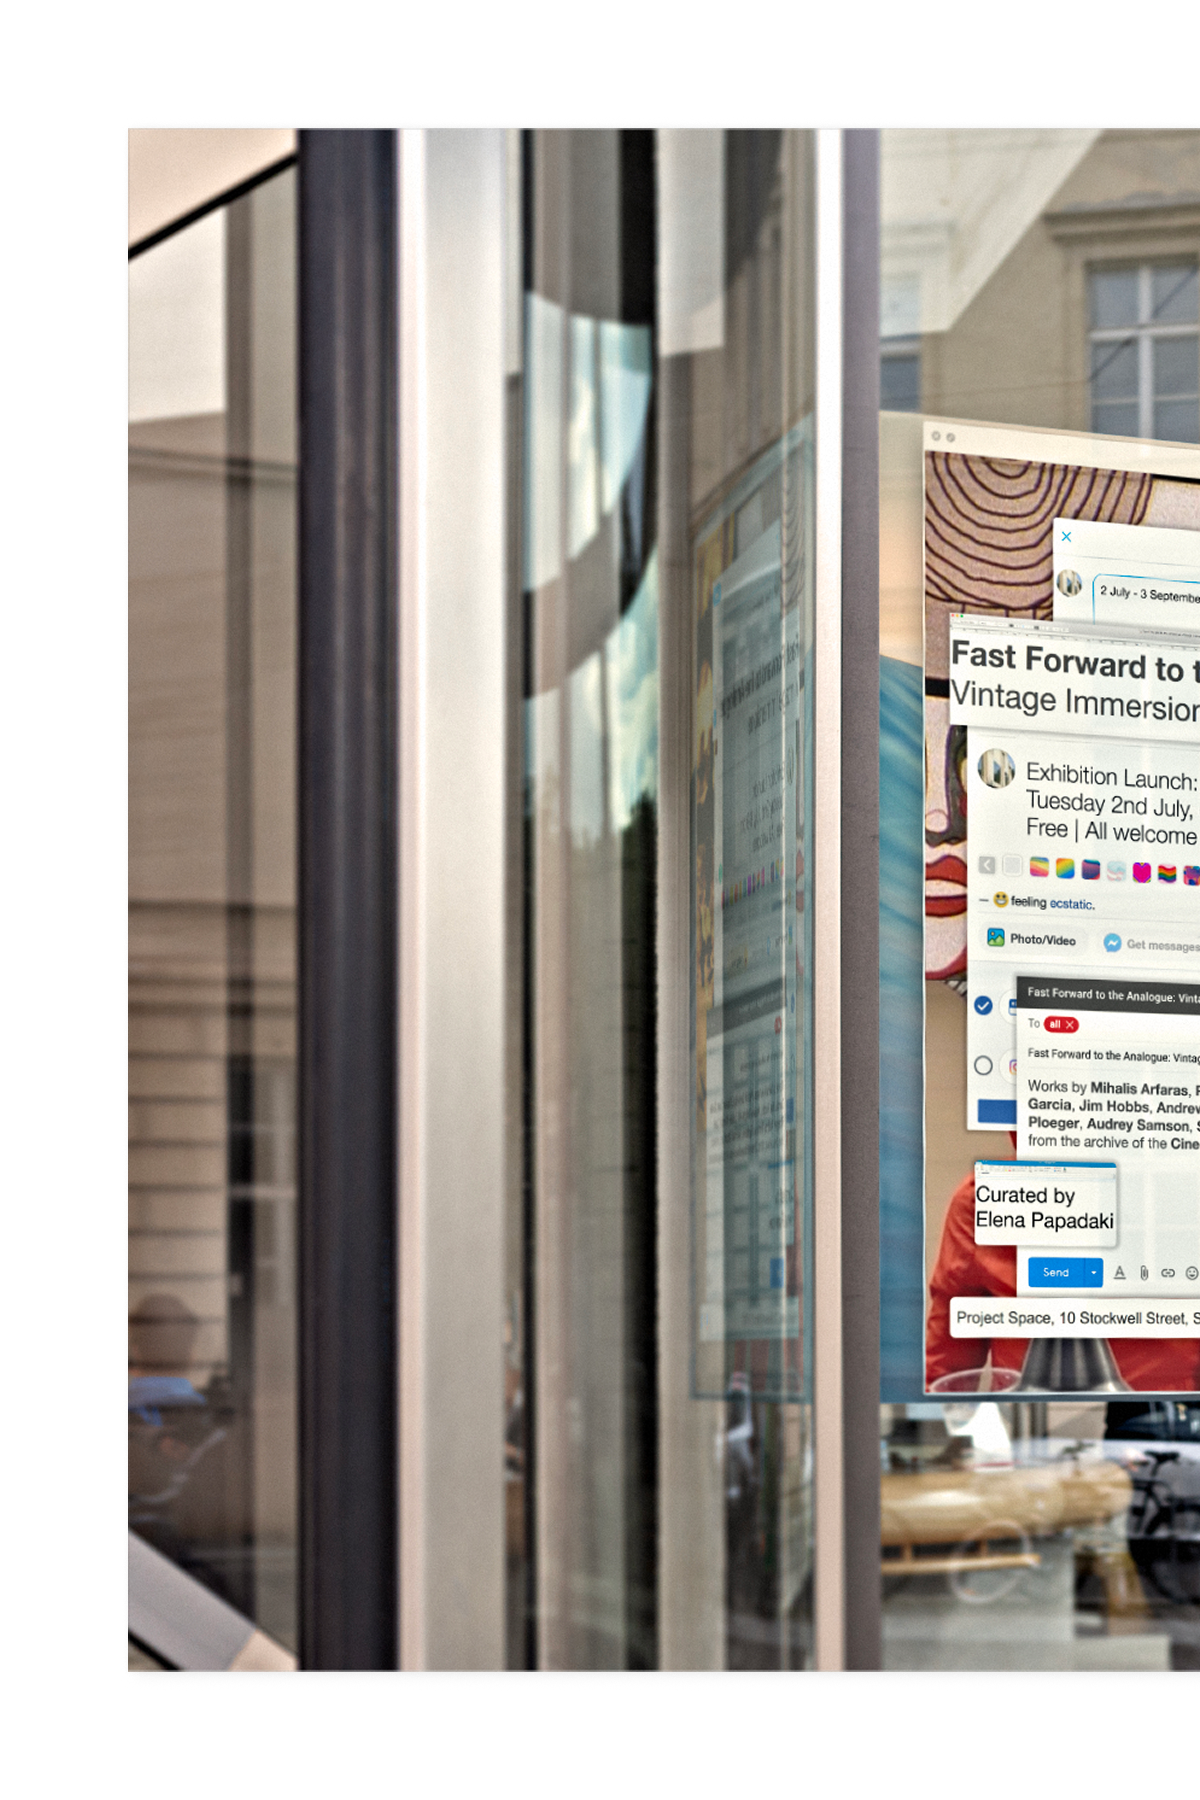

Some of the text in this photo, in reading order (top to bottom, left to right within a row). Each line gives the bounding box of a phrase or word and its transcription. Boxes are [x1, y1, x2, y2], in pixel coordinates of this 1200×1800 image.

[1101, 585, 1107, 596] 2
[1110, 586, 1131, 599] July
[1140, 588, 1147, 599] 3
[952, 639, 1016, 669] Fast
[1026, 645, 1146, 679] Forward
[1155, 657, 1185, 682] to
[951, 679, 1056, 717] Vintage
[1026, 762, 1198, 791] Exhibition Launch:
[1026, 789, 1105, 816] Tuesday
[1111, 795, 1147, 815] 2nd
[1153, 798, 1194, 821] July,
[1026, 817, 1068, 838] Free
[1085, 821, 1107, 840] All
[1113, 825, 1198, 845] welcome
[1011, 896, 1047, 910] feeling
[1050, 898, 1096, 911] ecstatic.
[1010, 933, 1076, 946] Photo/Video
[1127, 938, 1200, 953] Get messages
[1028, 987, 1050, 998] Fast
[1052, 988, 1092, 999] Forward
[1095, 990, 1106, 1000] to
[1108, 990, 1124, 1001] the
[1126, 991, 1176, 1004] Analogue:
[1028, 1018, 1040, 1028] To
[1050, 1019, 1061, 1029] all
[1028, 1048, 1049, 1058] Fast
[1052, 1049, 1091, 1060] Forward
[1093, 1051, 1104, 1060] to
[1106, 1050, 1121, 1061] the
[1123, 1051, 1171, 1064] Analogue:
[1028, 1079, 1068, 1093] Works
[1072, 1081, 1087, 1095] by
[1091, 1082, 1137, 1095] Mihalis
[1140, 1083, 1192, 1098] Arfaras,
[1028, 1098, 1075, 1112] Garcia,
[1079, 1099, 1102, 1112] Jim
[1107, 1100, 1153, 1115] Hobbs,
[1028, 1116, 1083, 1132] Ploeger,
[1087, 1118, 1133, 1133] Audrey
[1137, 1119, 1193, 1134] Samson,
[1028, 1134, 1057, 1147] from
[1061, 1134, 1081, 1147] the
[1084, 1135, 1129, 1148] archive
[1132, 1136, 1146, 1148] of
[1148, 1136, 1167, 1149] the
[976, 1184, 1075, 1208] Curated by
[976, 1210, 1114, 1233] Elena Papadaki
[1043, 1267, 1069, 1278] Send
[957, 1311, 1004, 1326] Project
[1008, 1312, 1055, 1326] Space,
[1060, 1312, 1076, 1324] 10
[1080, 1311, 1142, 1325] Stockwell
[1146, 1311, 1188, 1326] Street,
